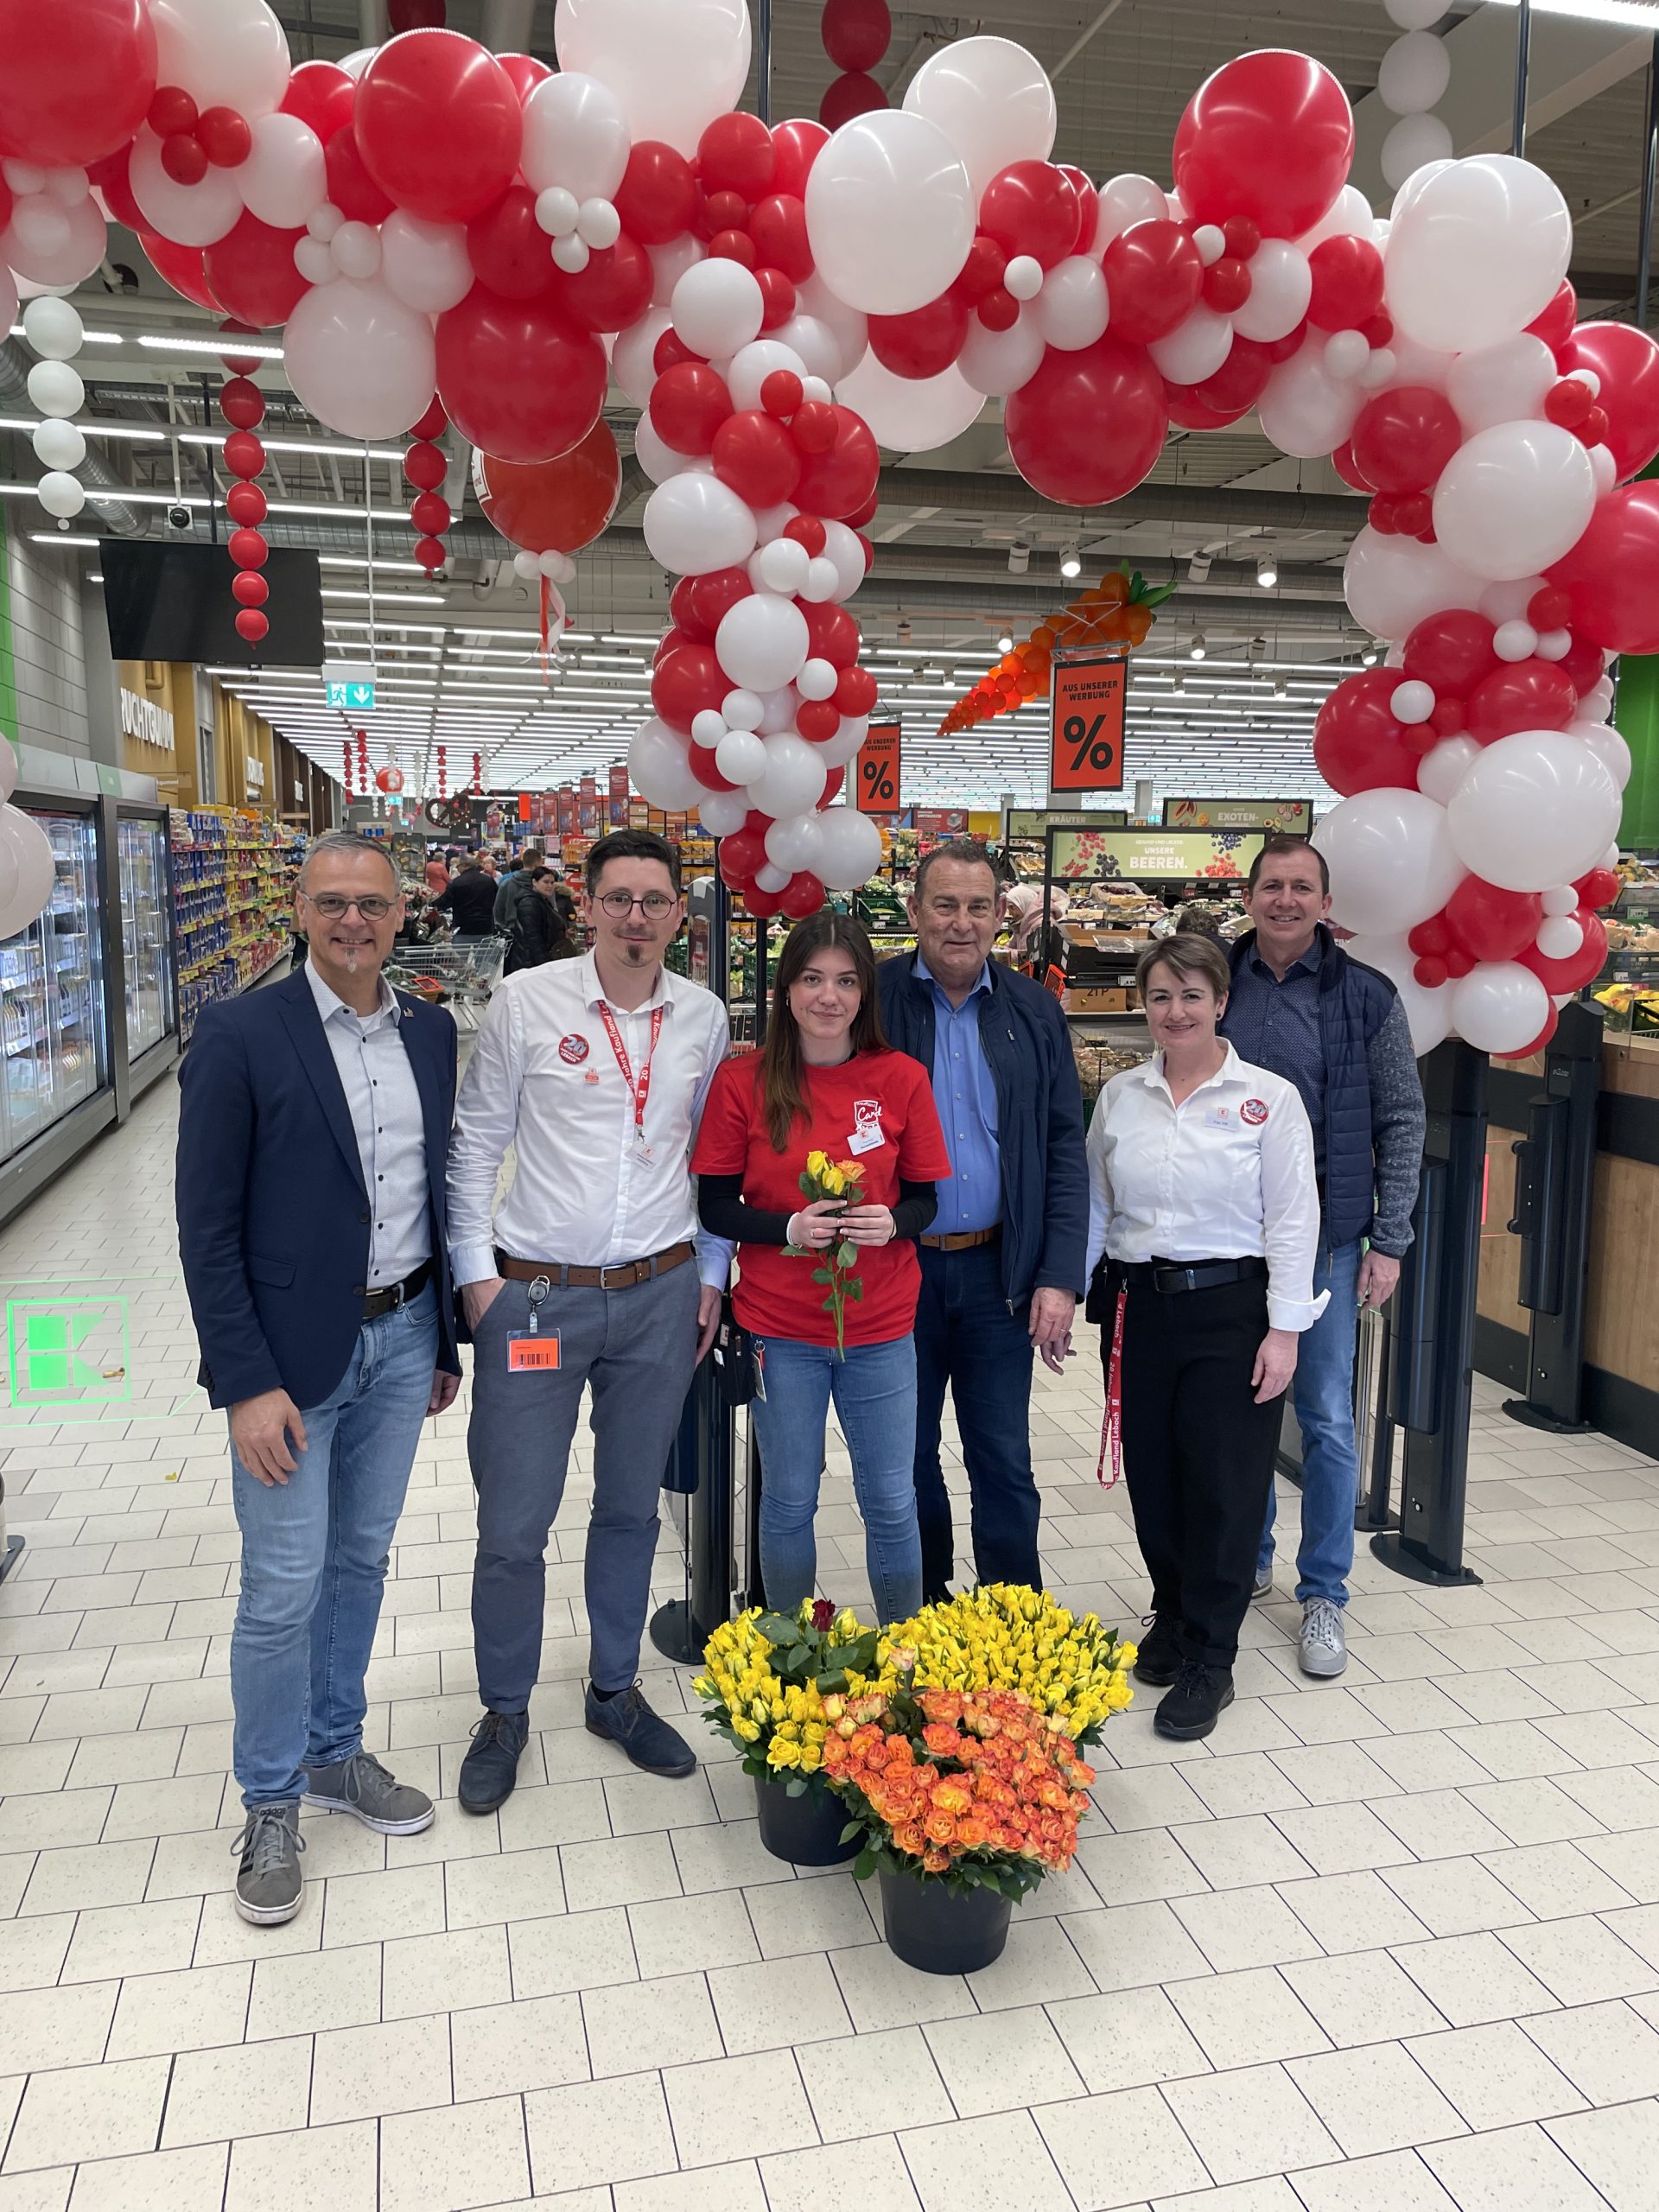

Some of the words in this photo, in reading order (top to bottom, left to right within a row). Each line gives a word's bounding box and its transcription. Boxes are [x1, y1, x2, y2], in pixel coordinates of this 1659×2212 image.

[1062, 683, 1078, 693] AUS
[1080, 680, 1118, 691] UNSERER
[1069, 690, 1110, 701] WERBUNG
[1063, 714, 1114, 771] %
[863, 761, 894, 799] %
[1049, 815, 1086, 823] KRÄUTER
[1217, 812, 1259, 822] EXOTEN-
[1129, 856, 1188, 869] BEEREN.
[603, 1015, 624, 1054] Kaufland
[562, 1035, 588, 1055] 20
[619, 1052, 632, 1079] Jahre
[640, 1069, 649, 1081] 20
[857, 1106, 883, 1122] Card
[1246, 1100, 1267, 1117] 20
[1113, 1310, 1123, 1338] Lebach
[1110, 1411, 1120, 1439] Lebach
[260, 1806, 287, 1816] adidas
